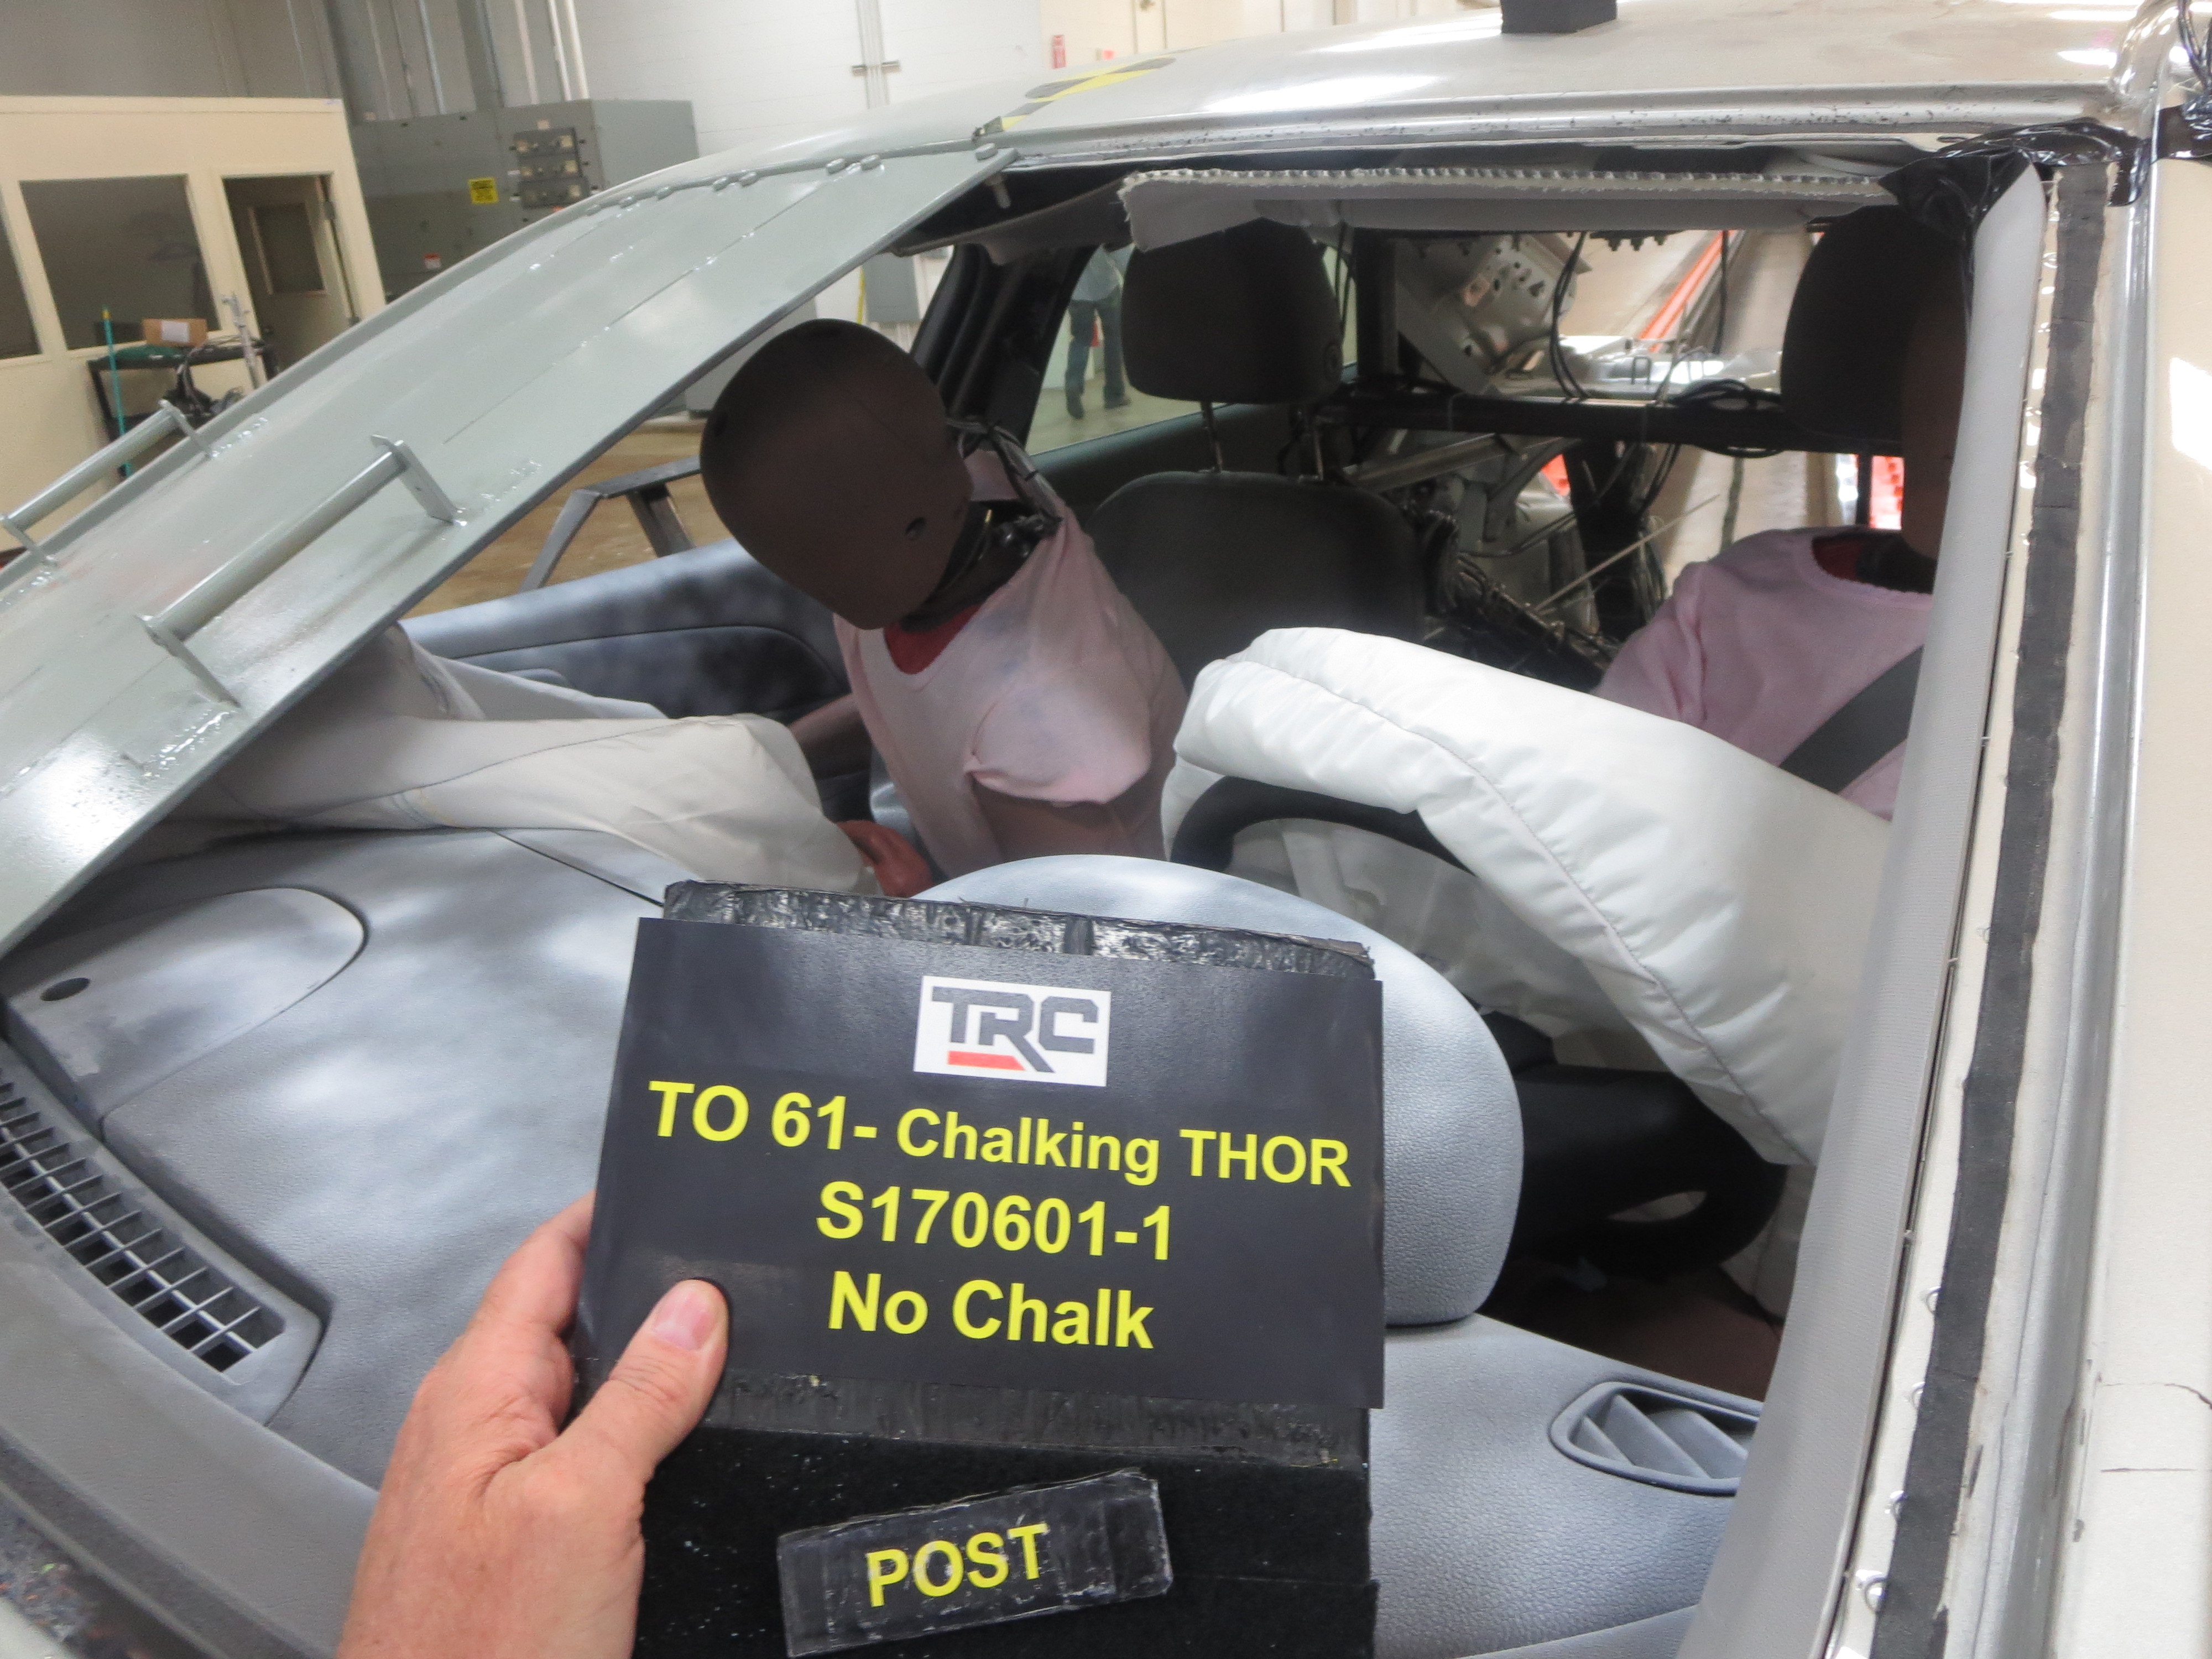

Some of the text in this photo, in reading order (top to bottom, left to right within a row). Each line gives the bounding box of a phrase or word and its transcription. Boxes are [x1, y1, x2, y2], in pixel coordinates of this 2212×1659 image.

[931, 985, 1099, 1073] TRC
[648, 1081, 1351, 1187] TO 61- Chalking THOR
[816, 1181, 1170, 1260] S170601-1
[828, 1270, 1154, 1349] No Chalk
[867, 1524, 1047, 1607] POST
